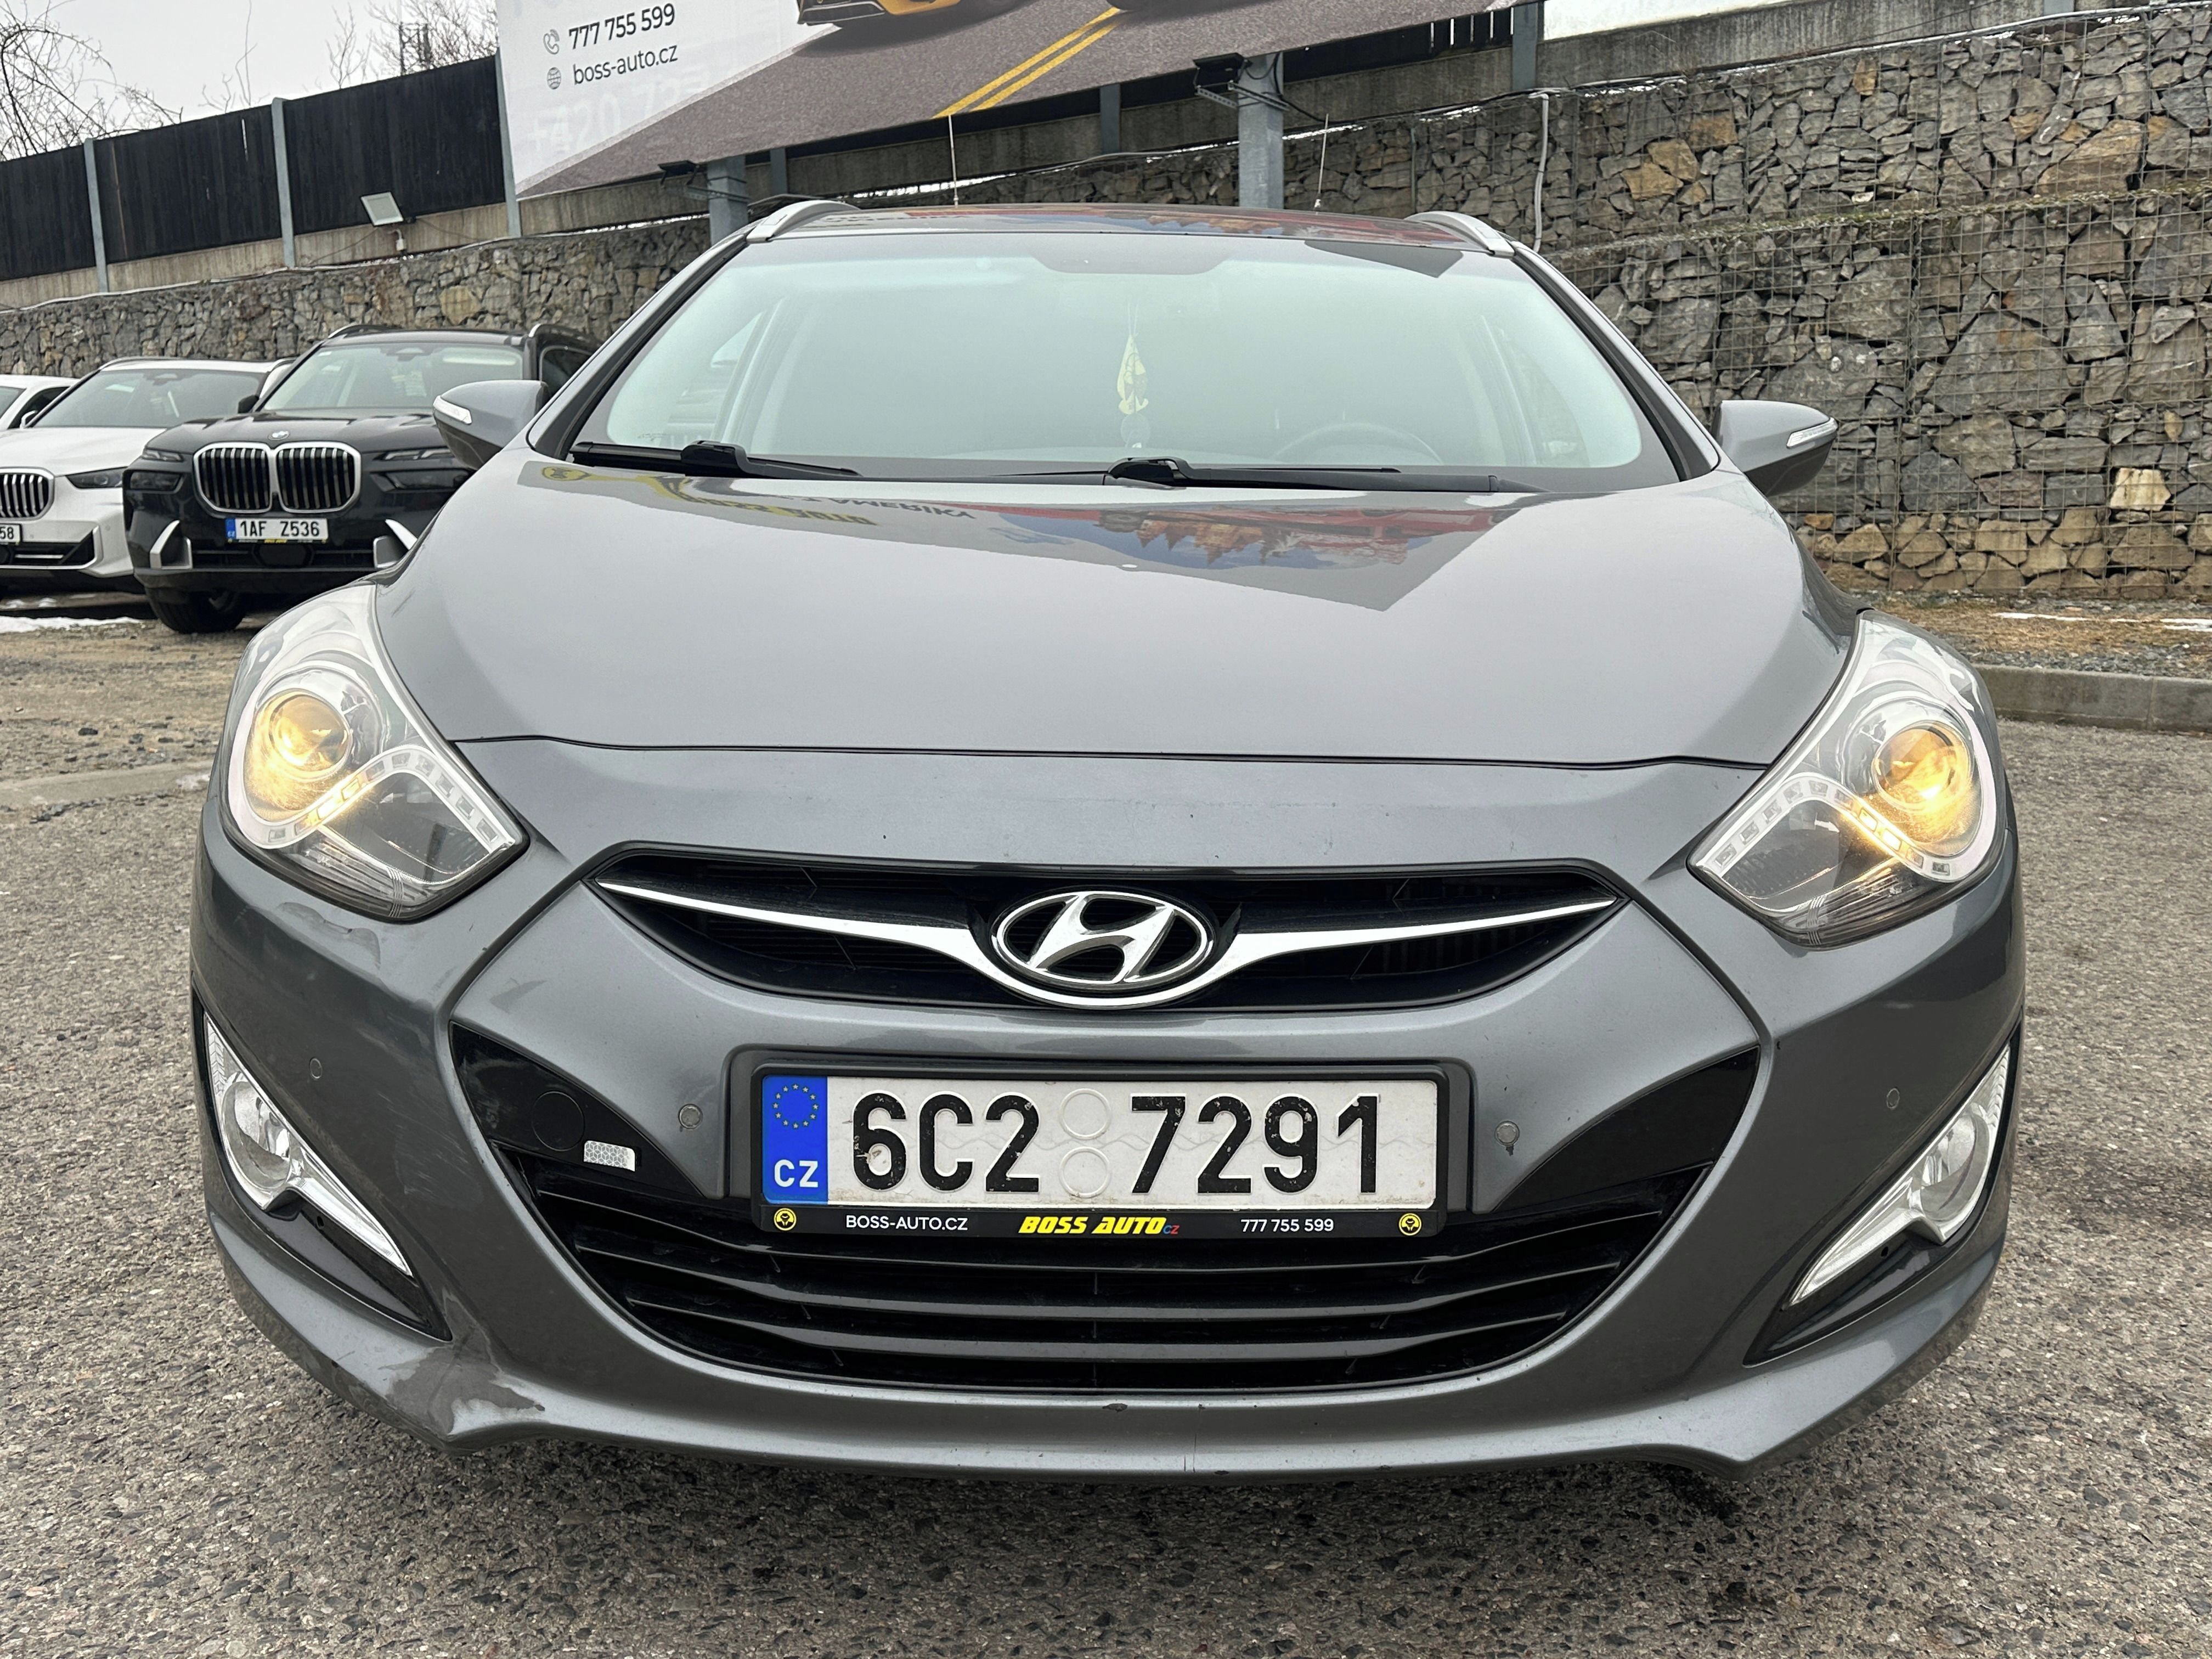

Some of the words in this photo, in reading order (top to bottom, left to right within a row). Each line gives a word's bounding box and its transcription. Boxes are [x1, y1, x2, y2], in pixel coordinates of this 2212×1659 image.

[569, 21, 600, 49] 777
[605, 12, 636, 40] 755
[641, 3, 675, 31] 599
[573, 45, 678, 85] boss-auto.cz
[240, 521, 267, 537] 1AF
[280, 521, 319, 537] Z536
[853, 1092, 1040, 1193] 6C2
[1131, 1094, 1379, 1194] 7291
[774, 1159, 819, 1188] CZ
[846, 1215, 968, 1231] BOSS-AUTO.CZ
[1018, 1216, 1087, 1234] BOSS
[1241, 1219, 1266, 1232] 777
[1272, 1219, 1300, 1232] 755
[1304, 1219, 1334, 1232] 599
